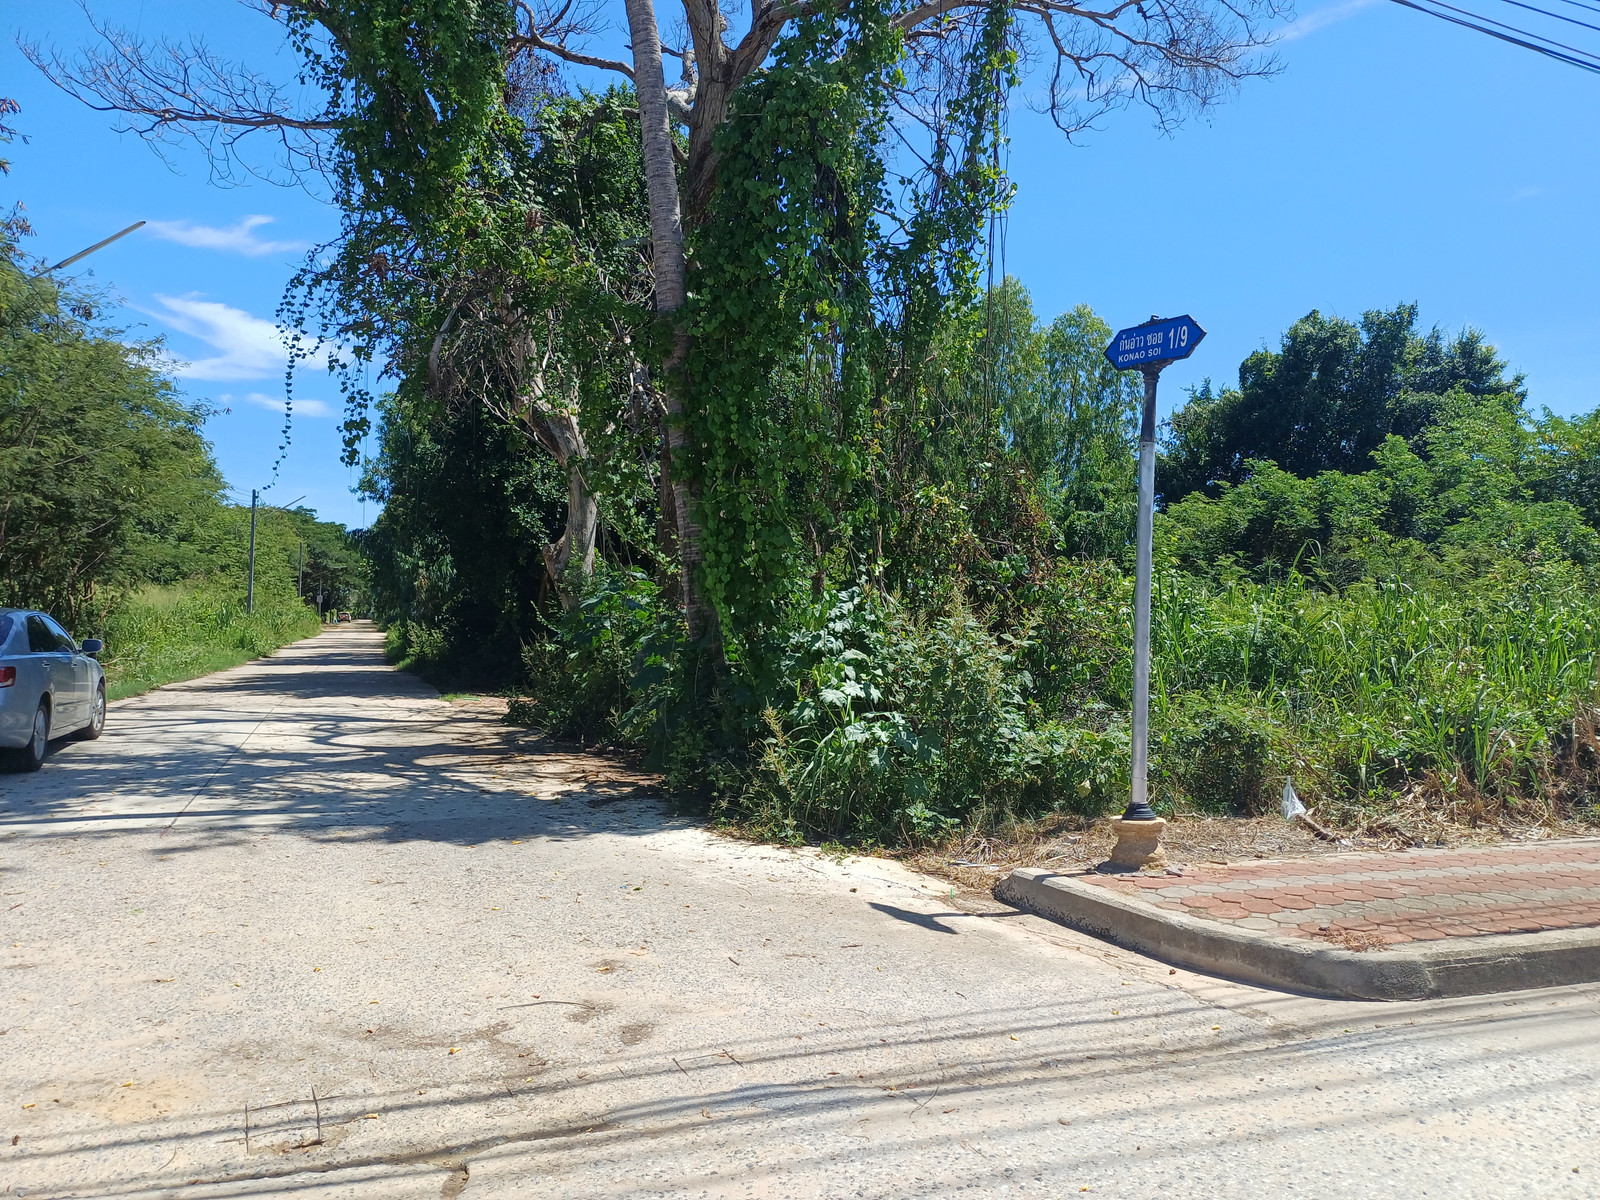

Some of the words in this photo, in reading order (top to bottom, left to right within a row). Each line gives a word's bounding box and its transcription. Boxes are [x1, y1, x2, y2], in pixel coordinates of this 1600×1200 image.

[1147, 332, 1163, 346] ซอย
[1169, 325, 1188, 349] 1/9
[1118, 350, 1145, 363] KONAO
[1148, 347, 1161, 357] SOI
